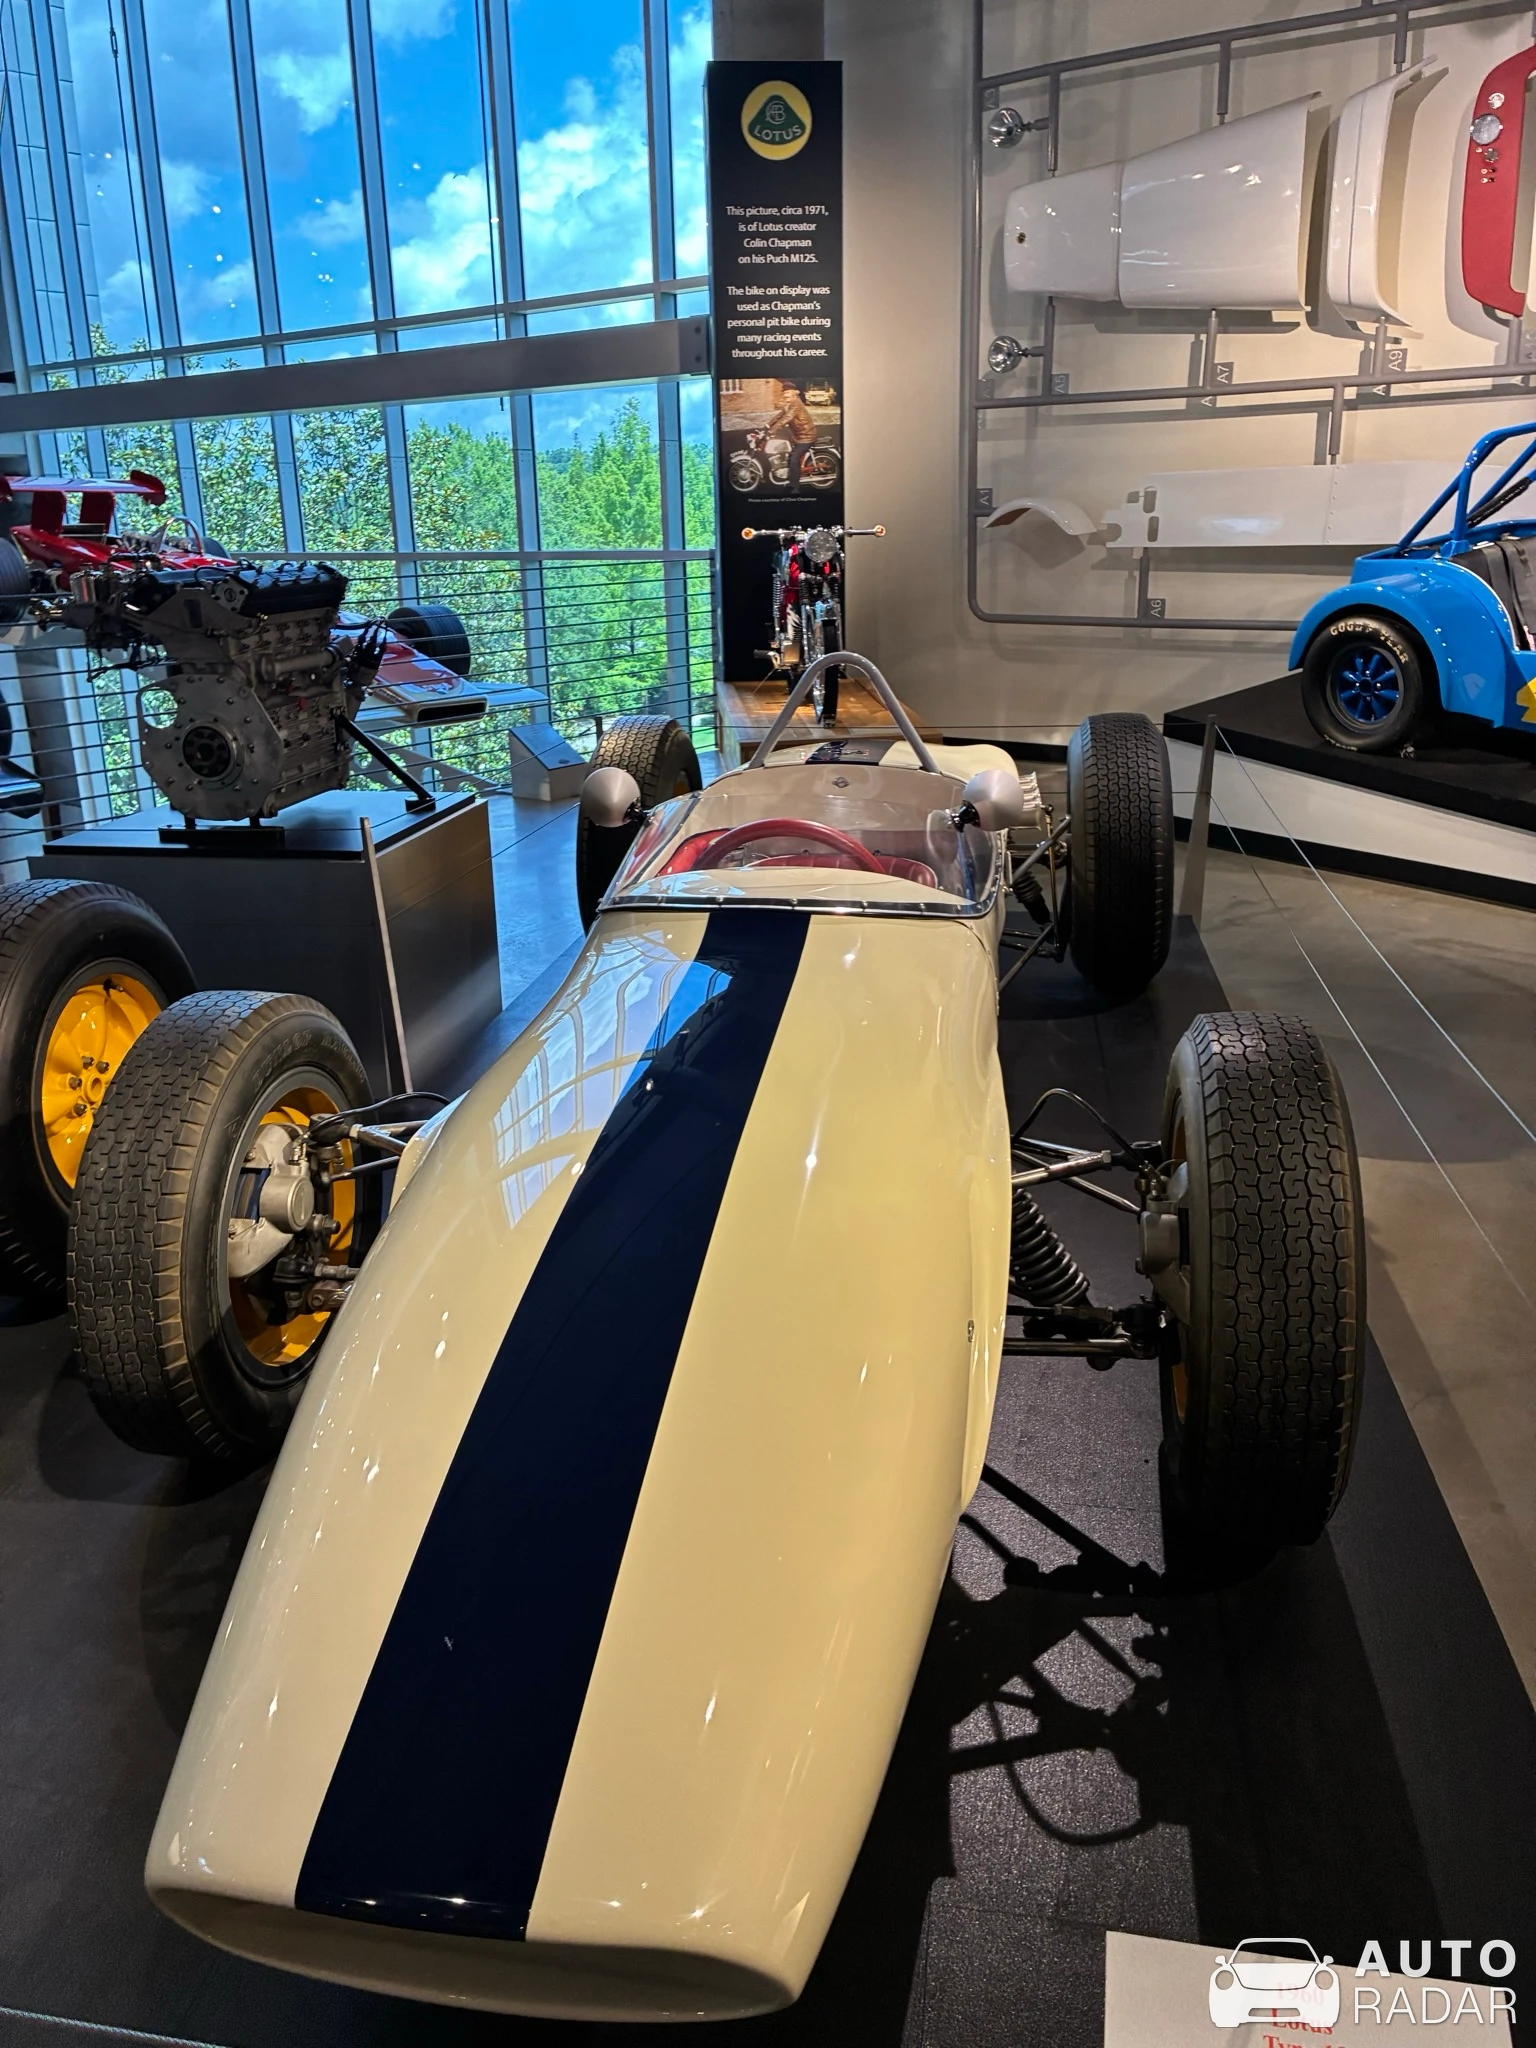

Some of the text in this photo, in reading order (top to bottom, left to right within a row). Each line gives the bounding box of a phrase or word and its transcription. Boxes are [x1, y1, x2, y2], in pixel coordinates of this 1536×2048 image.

[754, 125, 801, 141] LOTUS
[726, 205, 829, 217] This picture, circa 1971,
[738, 222, 817, 231] is of Lotus creator
[744, 238, 811, 249] Colin Chapman
[752, 255, 765, 263] his
[767, 254, 789, 263] Puch
[790, 254, 818, 263] M125.
[727, 286, 744, 295] The
[746, 286, 764, 295] bike
[780, 286, 810, 296] display
[737, 302, 759, 311] used
[727, 317, 831, 329] personal pit bike during
[737, 333, 822, 344] many racing events
[732, 348, 828, 359] throughout his career.
[1388, 350, 1402, 371] A9
[1217, 365, 1229, 383] A7
[979, 490, 990, 505] A1
[1150, 600, 1161, 618] A6
